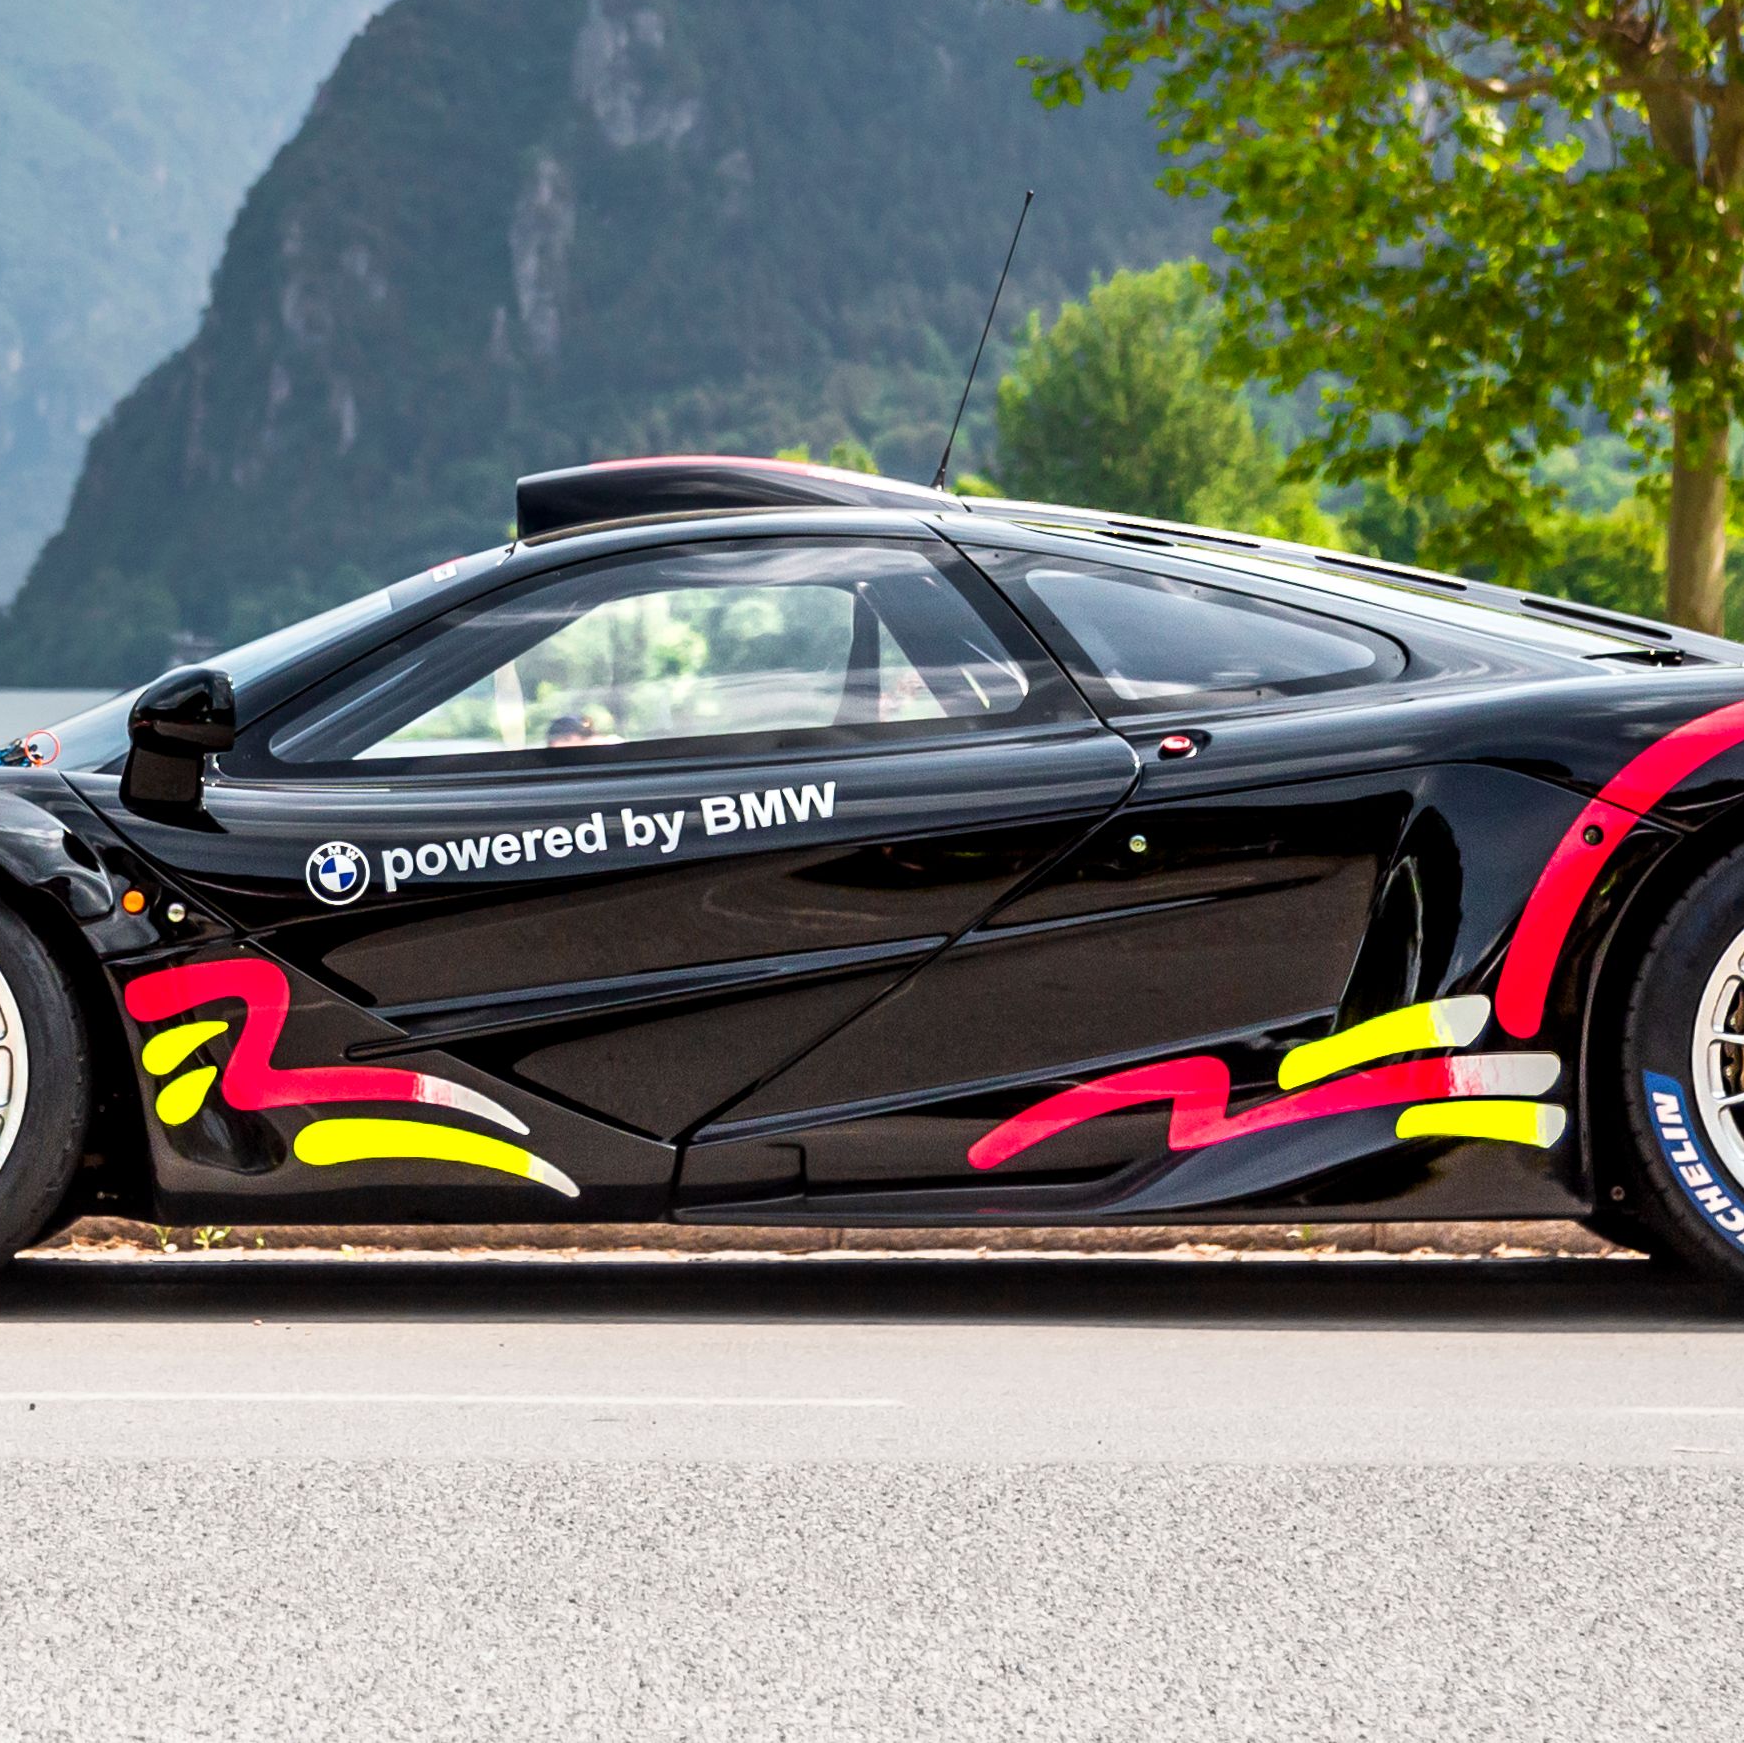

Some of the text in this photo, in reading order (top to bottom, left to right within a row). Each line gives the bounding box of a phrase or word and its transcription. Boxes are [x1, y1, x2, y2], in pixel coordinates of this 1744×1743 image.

[381, 781, 837, 892] powered by BMW
